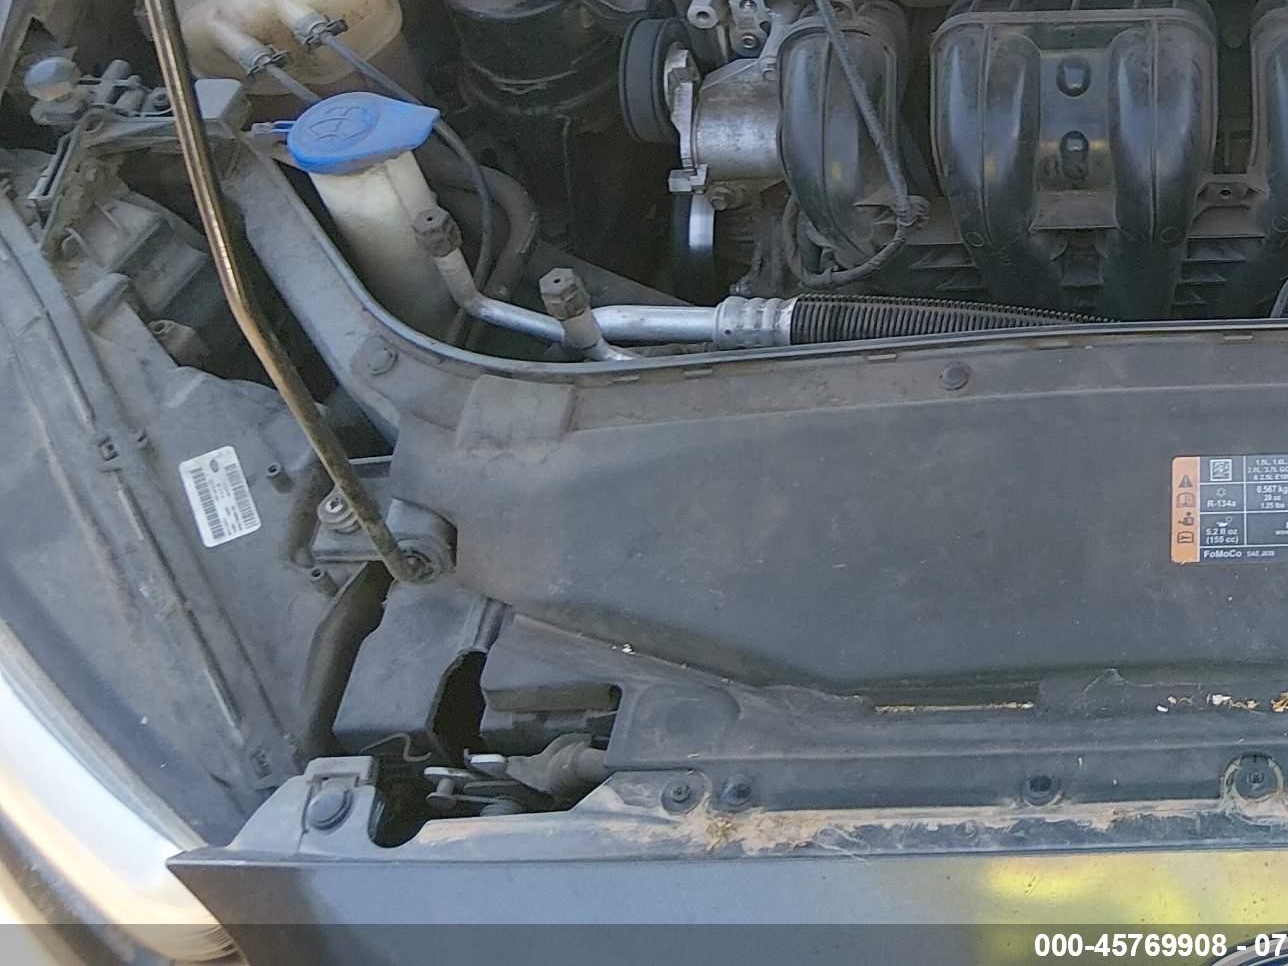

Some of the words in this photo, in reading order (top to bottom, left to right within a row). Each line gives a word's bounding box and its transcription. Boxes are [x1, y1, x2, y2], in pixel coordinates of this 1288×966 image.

[1279, 485, 1288, 494] kg
[1207, 499, 1236, 507] R-134a
[1206, 528, 1218, 536] 5.2
[1205, 536, 1225, 545] (155
[1225, 535, 1239, 544] cc)
[1203, 549, 1242, 558] FoMoCo
